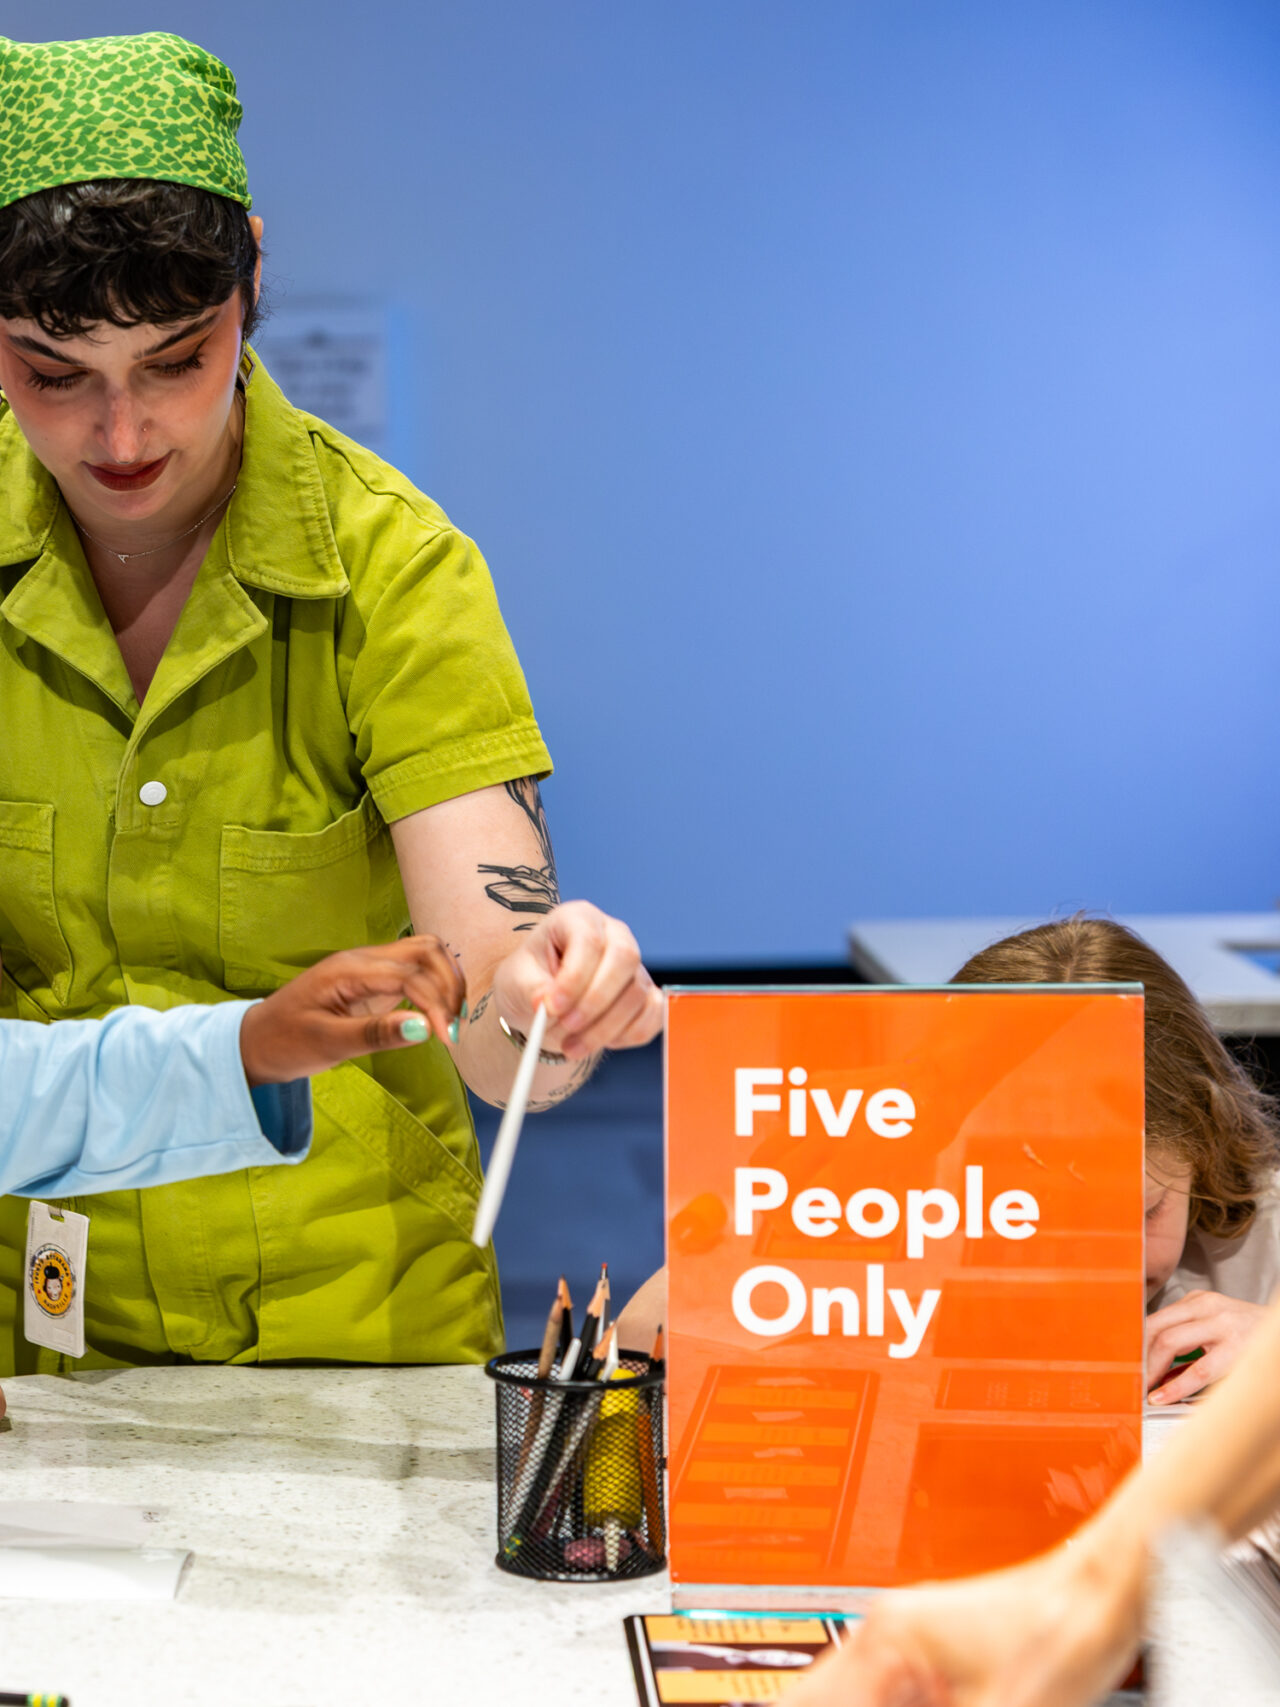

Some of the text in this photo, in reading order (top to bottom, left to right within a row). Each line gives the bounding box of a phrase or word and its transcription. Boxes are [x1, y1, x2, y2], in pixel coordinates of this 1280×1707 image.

[734, 1066, 916, 1139] Five
[733, 1164, 1041, 1260] People
[731, 1263, 942, 1360] Only
